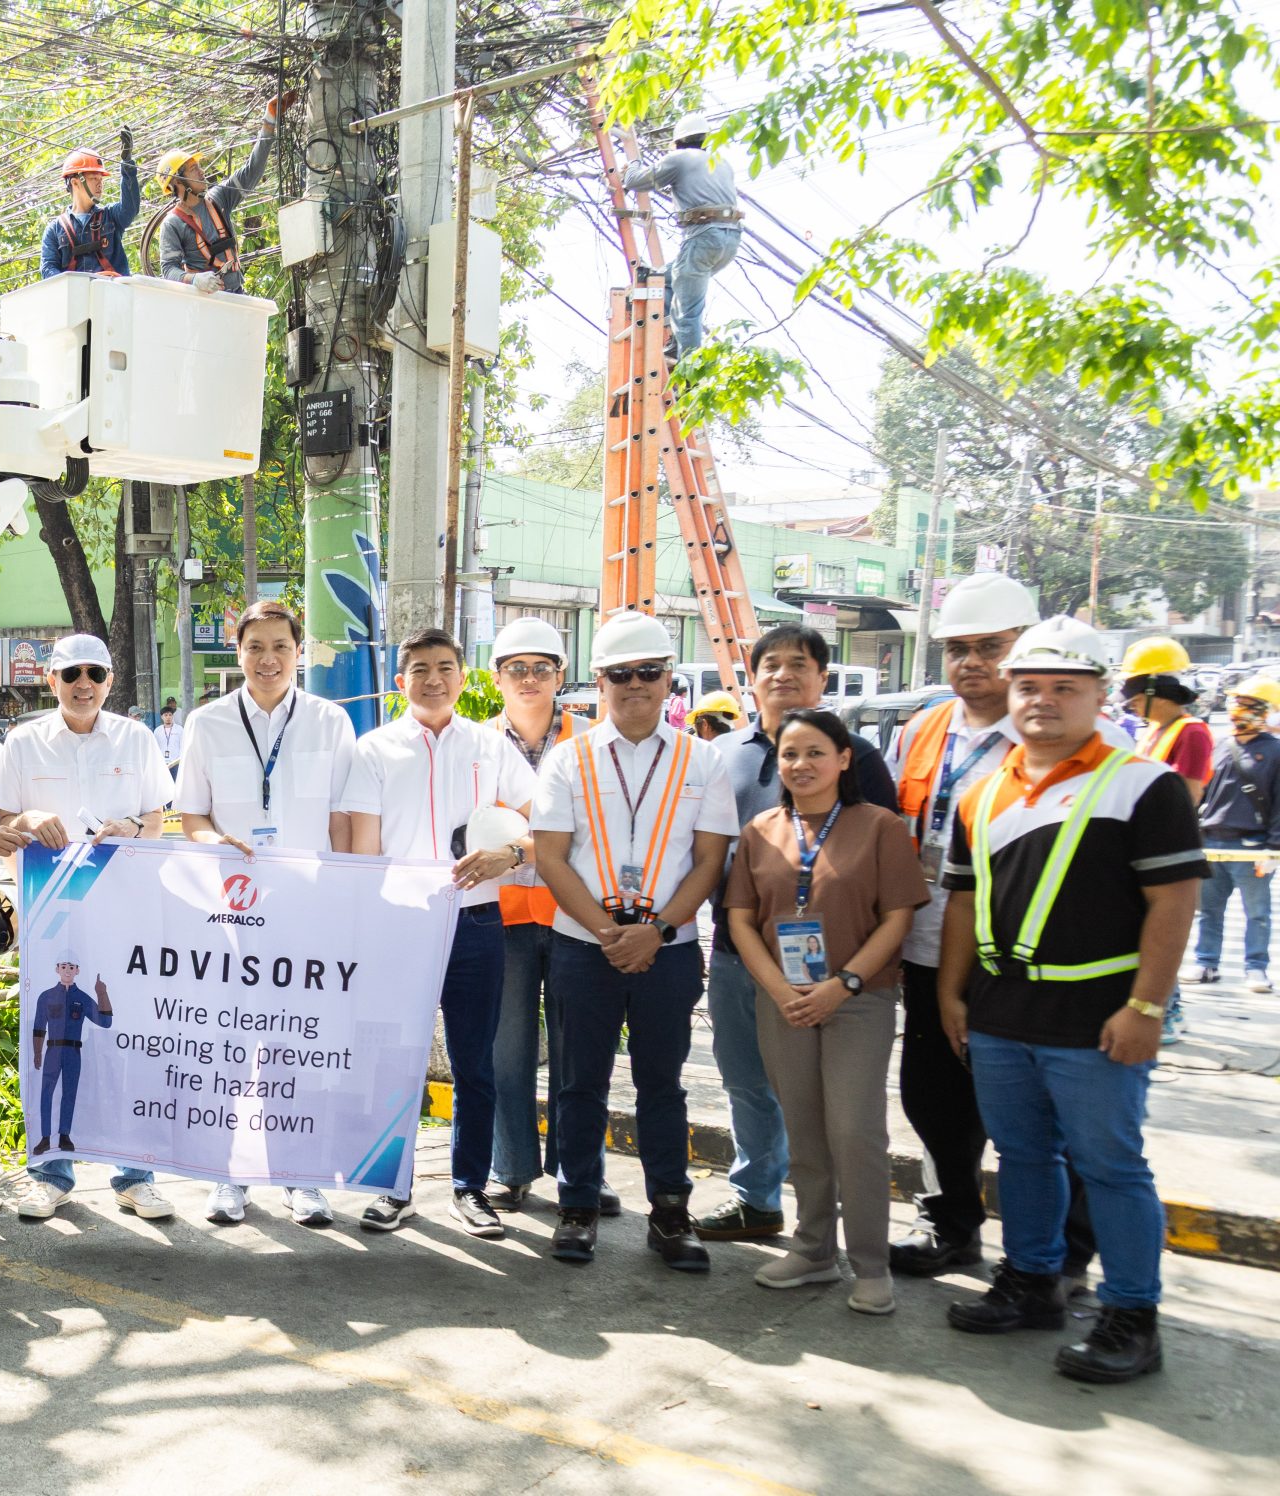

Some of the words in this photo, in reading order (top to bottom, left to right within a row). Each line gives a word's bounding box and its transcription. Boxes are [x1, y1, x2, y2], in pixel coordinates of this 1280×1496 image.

[306, 401, 333, 410] ANR003
[212, 654, 235, 663] EXIT
[207, 913, 265, 927] MERALCO
[126, 945, 358, 991] ADVISORY
[154, 997, 208, 1025] Wire
[218, 1006, 320, 1039] clearing
[116, 1032, 214, 1064] ongoing
[224, 1040, 246, 1063] to
[257, 1048, 352, 1069] prevent
[165, 1064, 203, 1091] fire
[214, 1071, 295, 1099] hazard
[133, 1099, 177, 1120] and
[187, 1106, 238, 1130] pole
[249, 1109, 314, 1133] down
